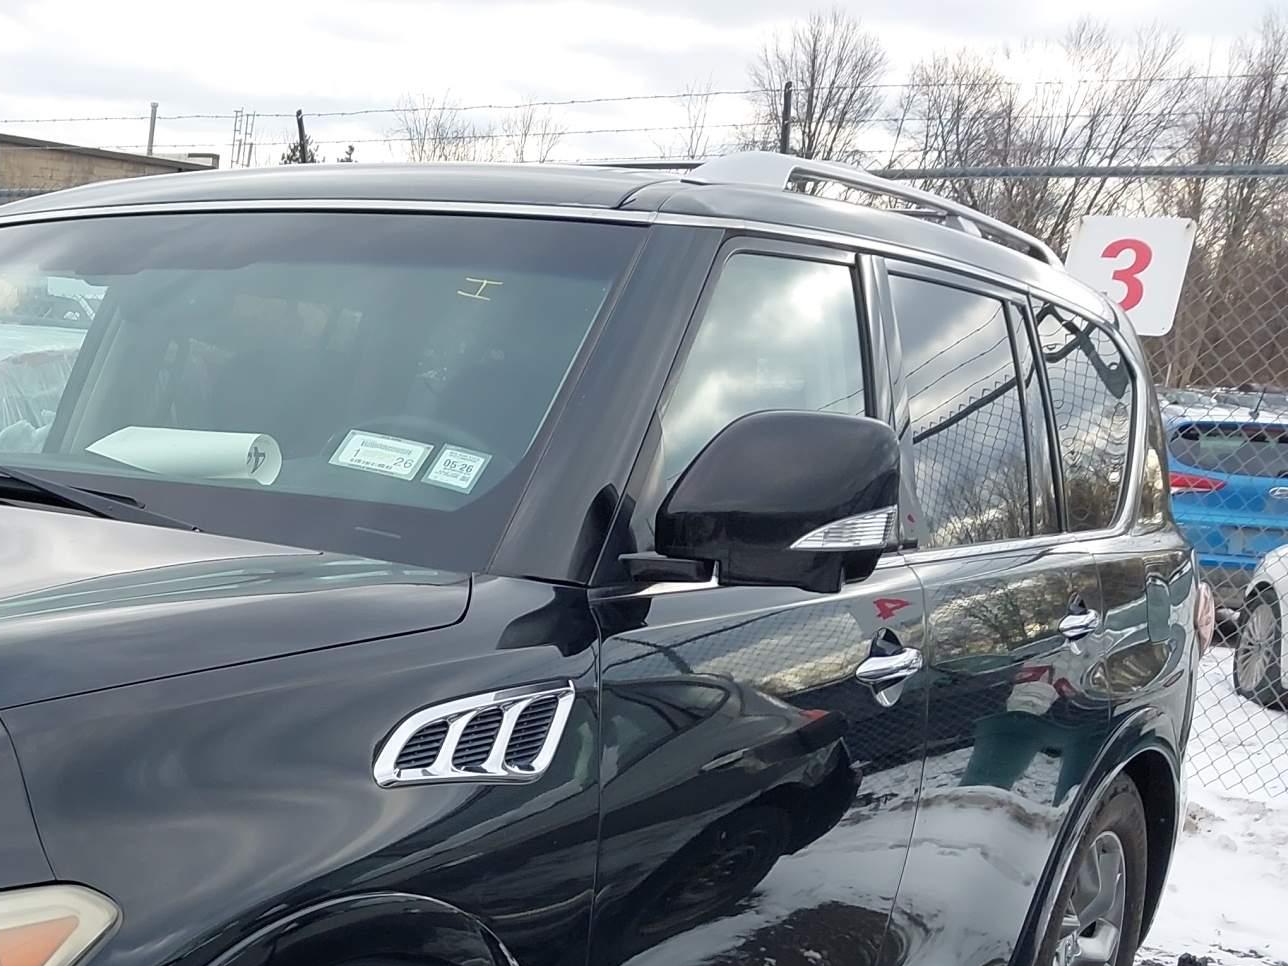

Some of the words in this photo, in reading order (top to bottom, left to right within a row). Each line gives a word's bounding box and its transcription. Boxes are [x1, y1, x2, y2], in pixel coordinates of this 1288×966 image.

[1100, 238, 1153, 312] 3
[392, 457, 415, 469] 26
[443, 458, 457, 469] 05
[459, 463, 474, 473] 26
